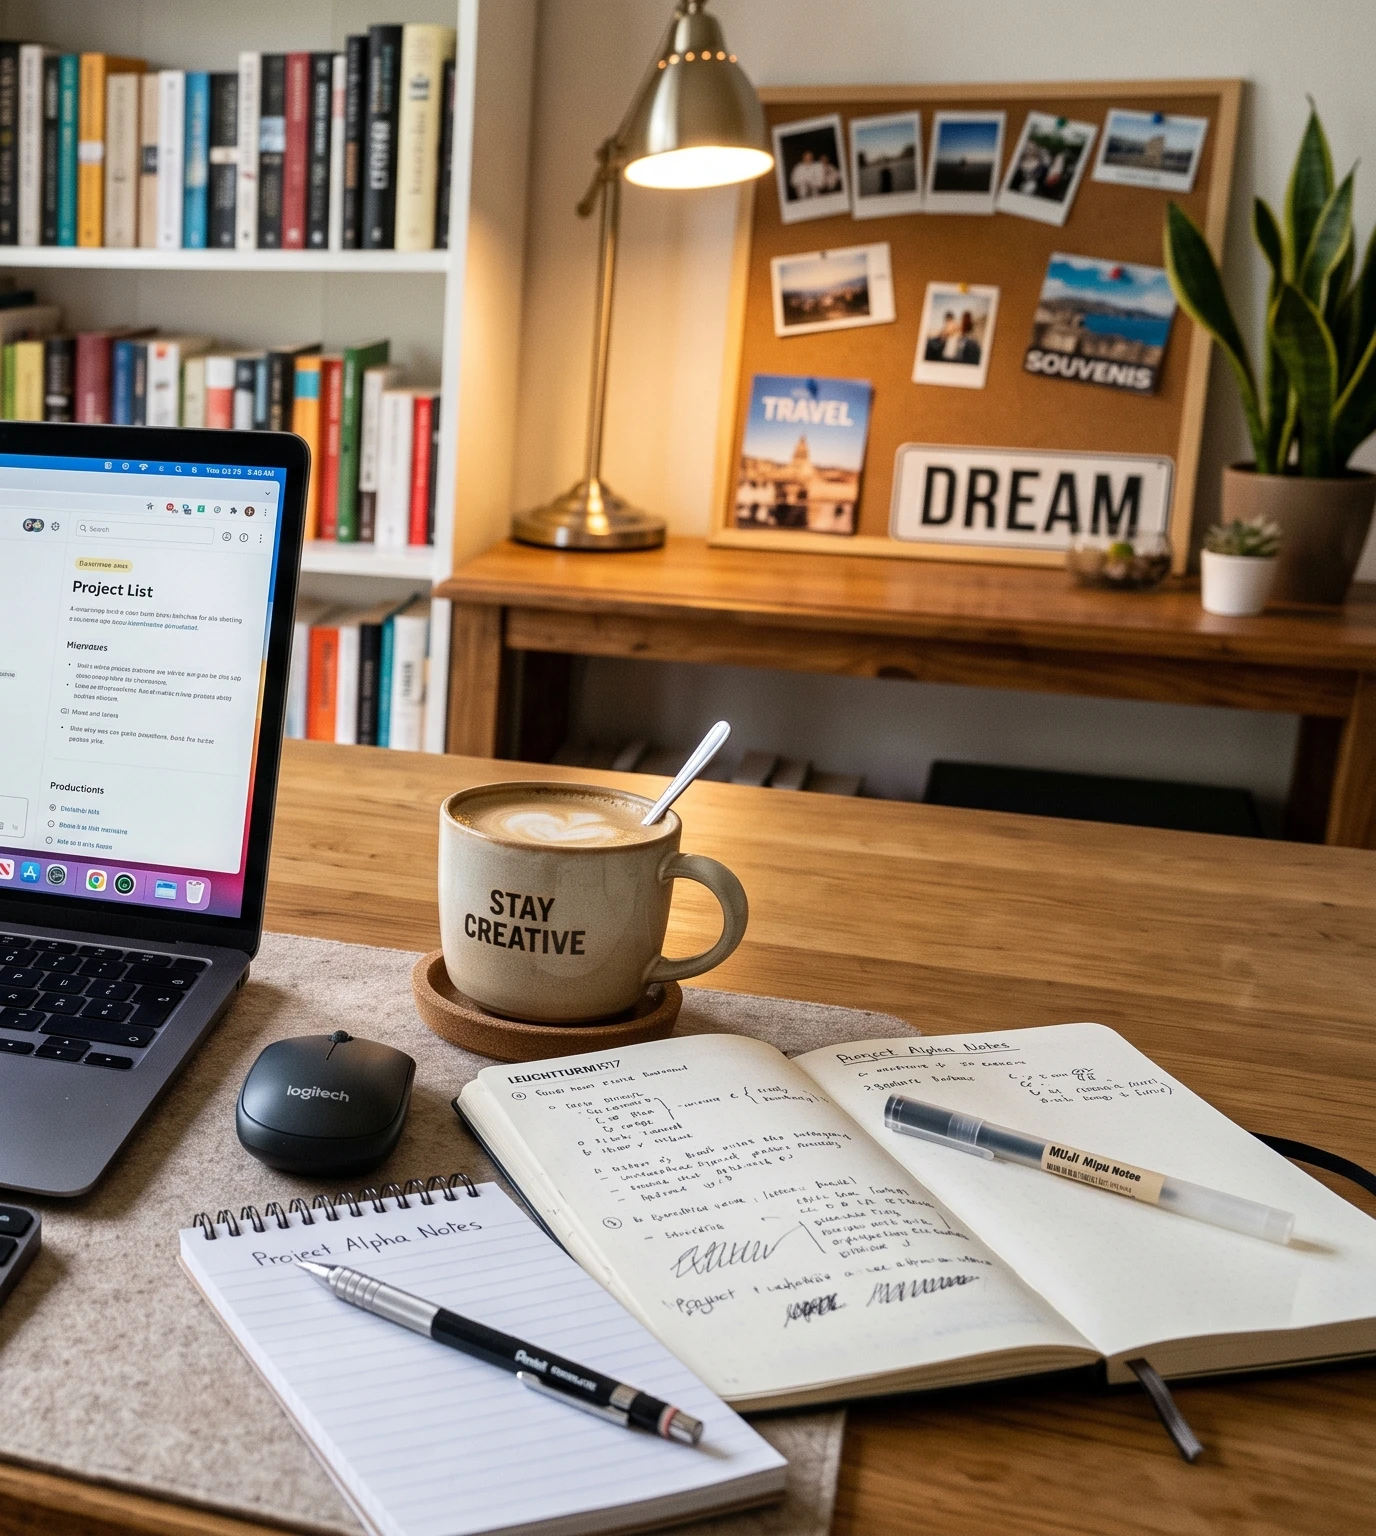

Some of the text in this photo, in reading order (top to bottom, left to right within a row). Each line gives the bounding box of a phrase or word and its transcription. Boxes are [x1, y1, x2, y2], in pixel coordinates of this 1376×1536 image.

[1025, 350, 1153, 389] SOUVENIS
[762, 395, 854, 427] TRAVEL
[921, 465, 1142, 538] DREAM
[72, 580, 154, 598] Project List
[489, 889, 555, 922] STAY
[464, 913, 586, 956] CREATIVE
[286, 1085, 350, 1103] logitech
[252, 1218, 483, 1267] Project Alpha Notes
